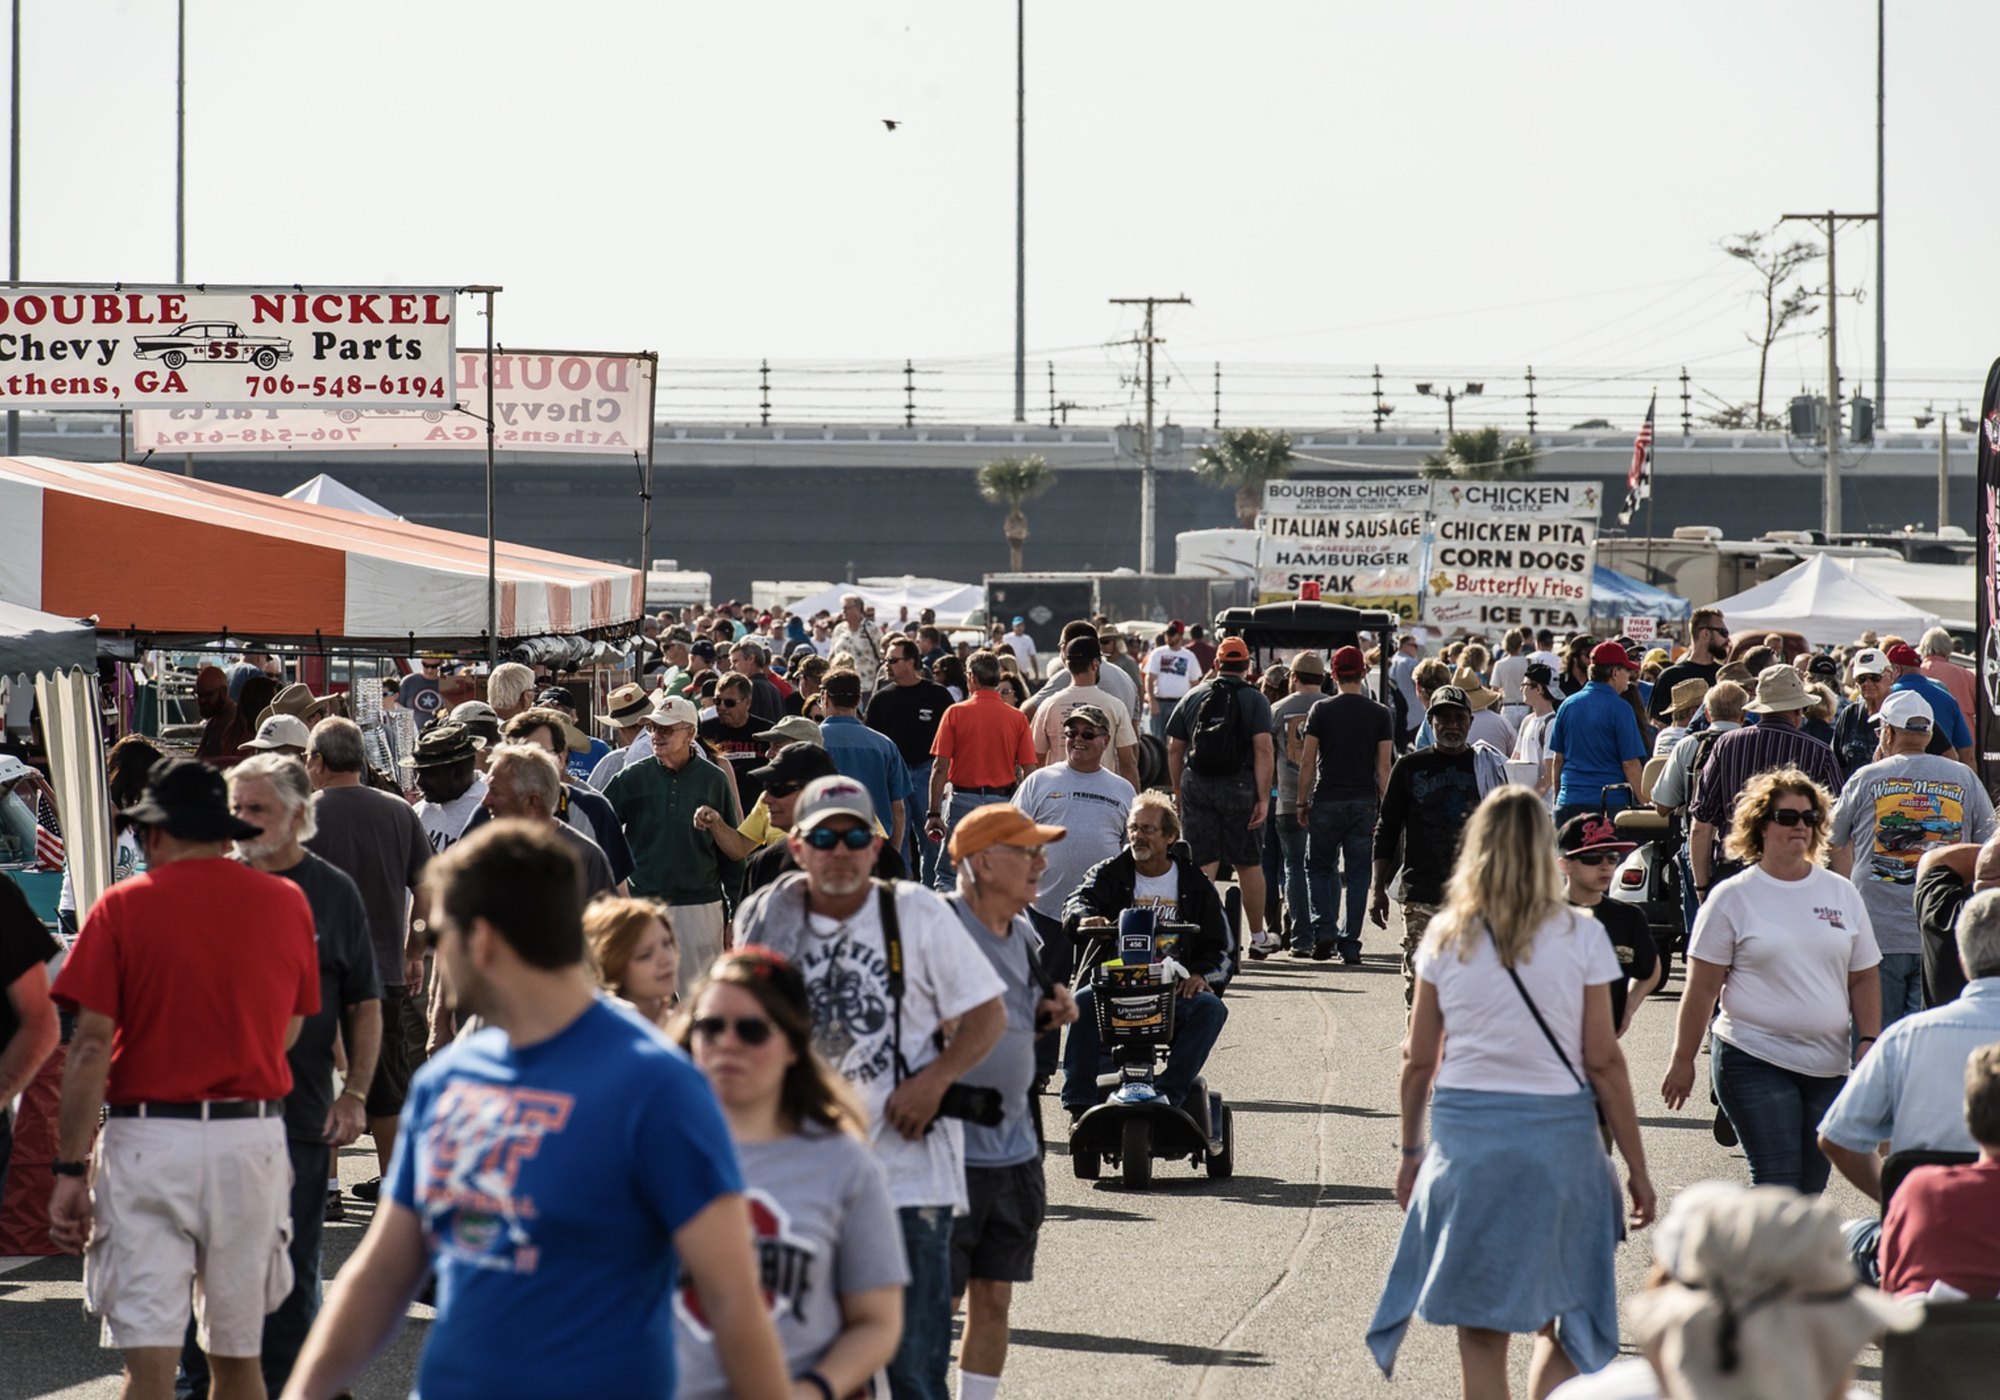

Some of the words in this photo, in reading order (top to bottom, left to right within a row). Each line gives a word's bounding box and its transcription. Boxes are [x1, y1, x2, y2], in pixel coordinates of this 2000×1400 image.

[0, 294, 188, 325] OUBLE
[250, 294, 450, 325] NICKEL
[0, 333, 120, 366] Chevy
[312, 331, 422, 360] Parts
[208, 342, 239, 359] 55
[0, 373, 120, 399] thens,
[134, 370, 188, 393] GA
[246, 374, 444, 398] 706-548-6194
[1269, 485, 1351, 498] BOURBON
[1356, 484, 1430, 498] CHICKEN
[1465, 487, 1569, 504] CHICKEN
[1491, 504, 1505, 512] ON
[1507, 504, 1515, 512] A
[1517, 504, 1543, 512] STICK
[1272, 518, 1340, 538] ITALIAN
[1345, 518, 1420, 538] SAUSAGE
[1440, 521, 1531, 541] CHICKEN
[1538, 524, 1585, 545] PITA
[1276, 552, 1409, 566] HAMBURGER
[1440, 549, 1512, 568] CORN
[1519, 551, 1585, 572] DOGS
[1287, 573, 1355, 592] STEAK
[1455, 574, 1539, 597] Butterfly
[1543, 578, 1583, 599] Fries
[1480, 605, 1522, 623] ICE
[1529, 608, 1578, 628] TEA
[1871, 780, 1911, 800] Winter
